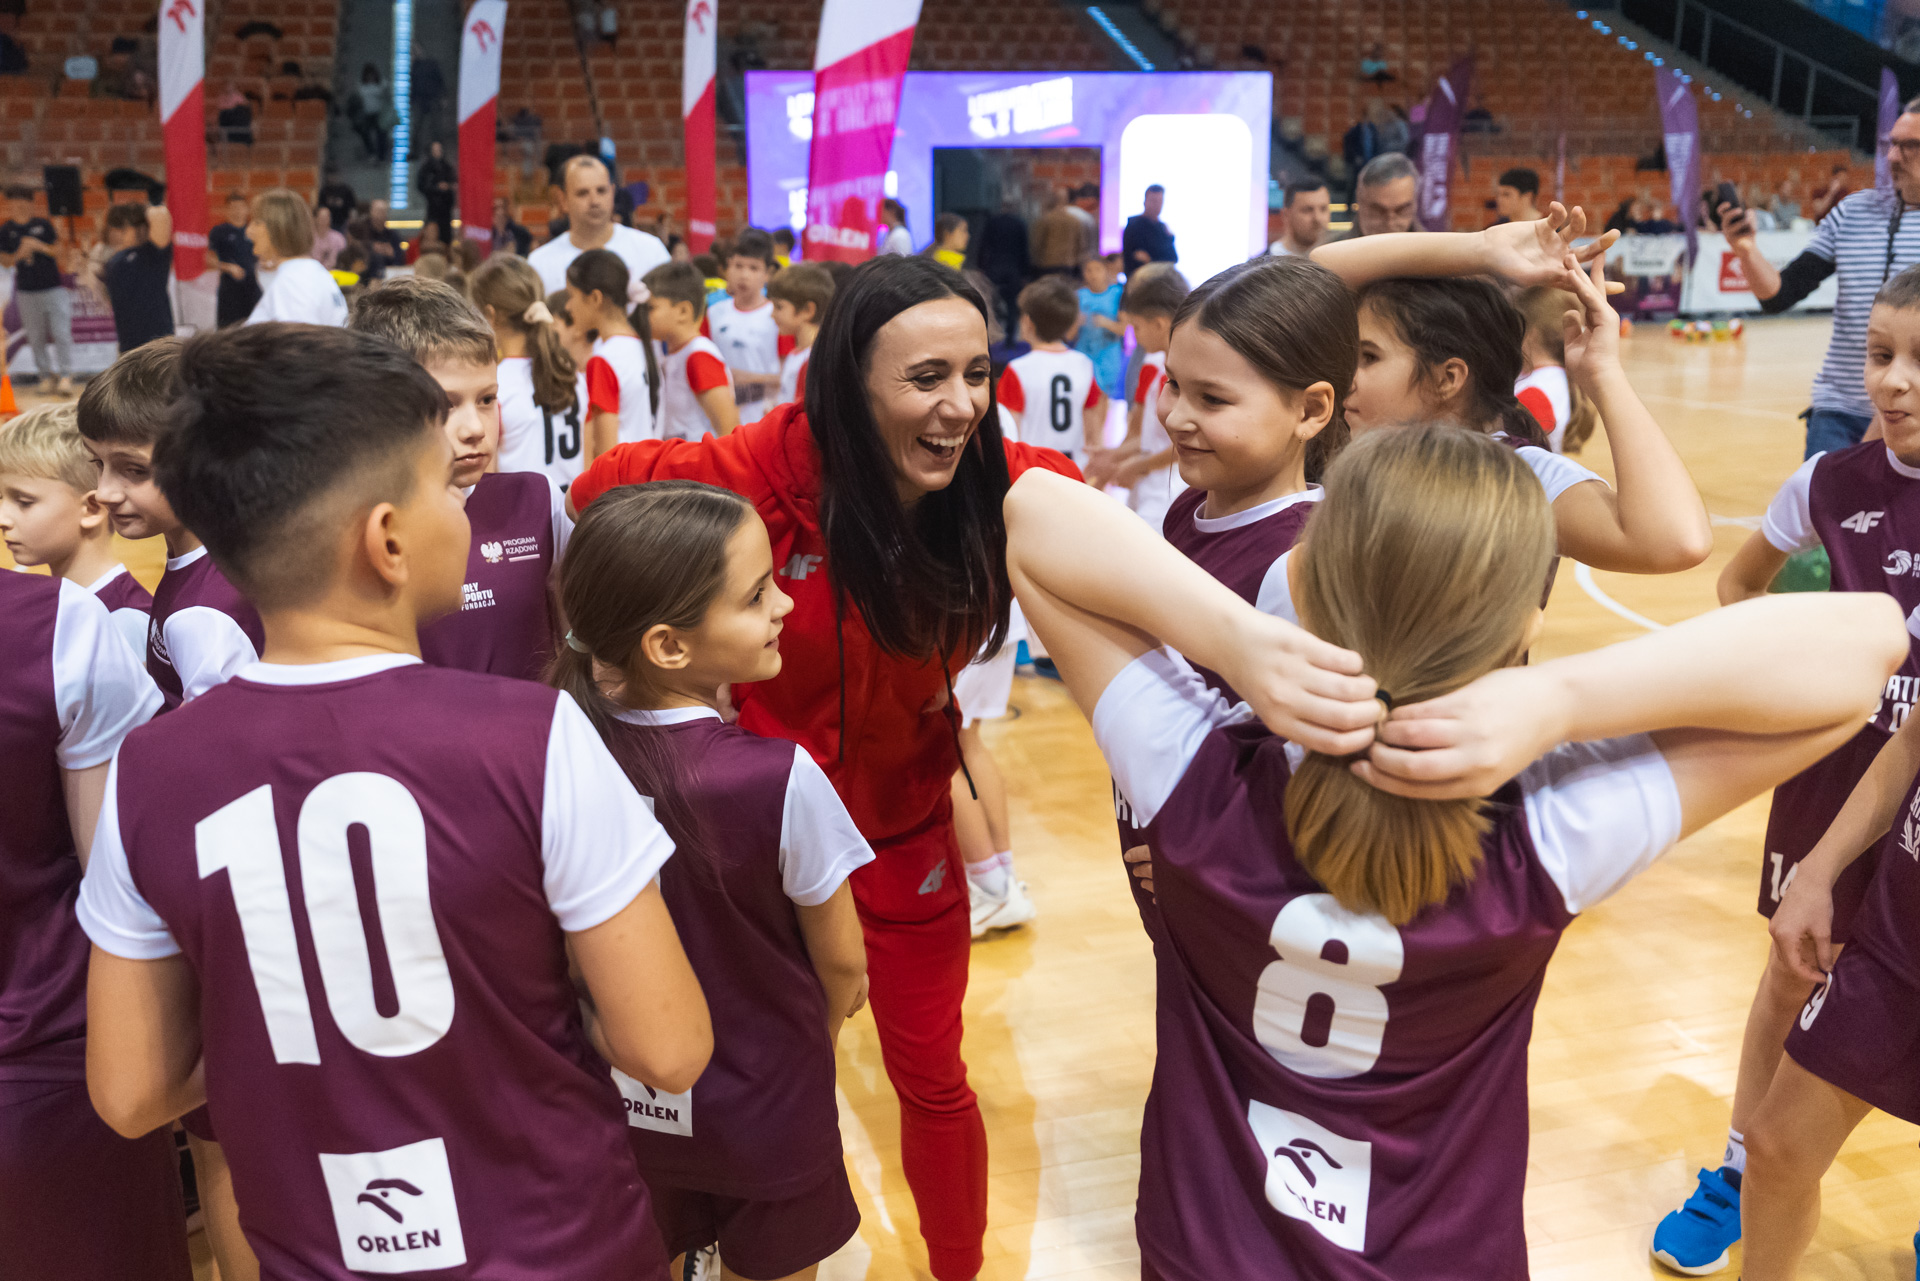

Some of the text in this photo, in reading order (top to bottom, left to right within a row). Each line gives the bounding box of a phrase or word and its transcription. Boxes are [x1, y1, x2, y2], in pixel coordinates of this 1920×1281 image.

[1051, 374, 1072, 432] 6
[541, 387, 580, 465] 13
[1840, 510, 1885, 534] 4F
[502, 536, 536, 547] PROGRAM
[505, 544, 539, 555] RZĄDOWY
[779, 553, 823, 580] 4F
[461, 582, 479, 594] RŁY
[462, 589, 494, 604] PORTU
[918, 859, 947, 895] 4F
[195, 771, 455, 1065] 10
[1253, 892, 1405, 1079] 8
[622, 1098, 679, 1122] ORLEN
[357, 1228, 442, 1253] ORLEN
